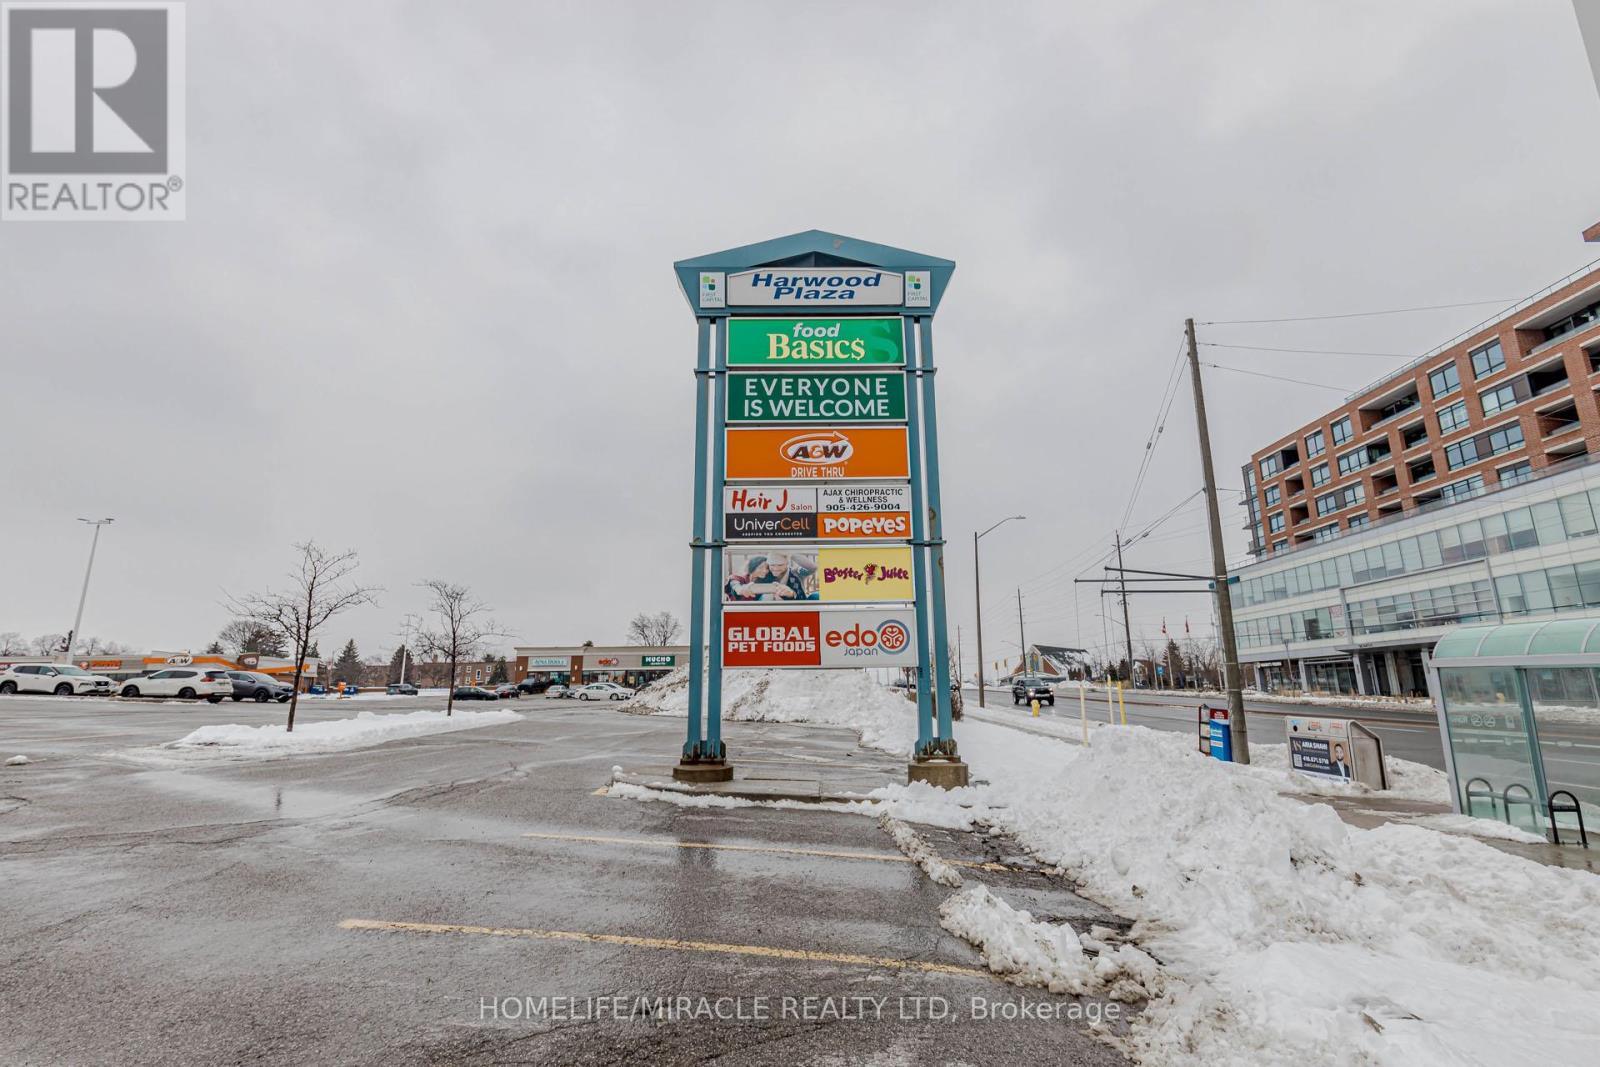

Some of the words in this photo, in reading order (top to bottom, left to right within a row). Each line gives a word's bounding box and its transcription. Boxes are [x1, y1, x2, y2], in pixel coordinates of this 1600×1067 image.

[751, 273, 882, 287] Harwood
[773, 286, 856, 300] Plaza
[792, 322, 841, 339] food
[745, 377, 889, 397] EVERYONE
[744, 399, 763, 417] IS
[769, 399, 890, 417] WELCOME
[791, 445, 849, 460] A&W
[791, 466, 818, 478] DRIVE
[821, 466, 845, 478] THRU
[823, 489, 843, 497] AJAX
[844, 488, 903, 496] CHIROPRACTIC
[732, 488, 772, 512] Hair
[776, 488, 788, 511] J
[790, 503, 813, 511] Salon
[838, 496, 844, 504] &
[846, 496, 888, 504] WELLNESS
[825, 503, 901, 512] 905-426-9004
[734, 517, 810, 531] UniverCell
[824, 566, 863, 584] Booster
[877, 566, 909, 581] Juice
[728, 626, 816, 642] GLOBAL
[825, 623, 878, 647] edo
[728, 641, 758, 652] PET
[763, 641, 816, 652] FOODS
